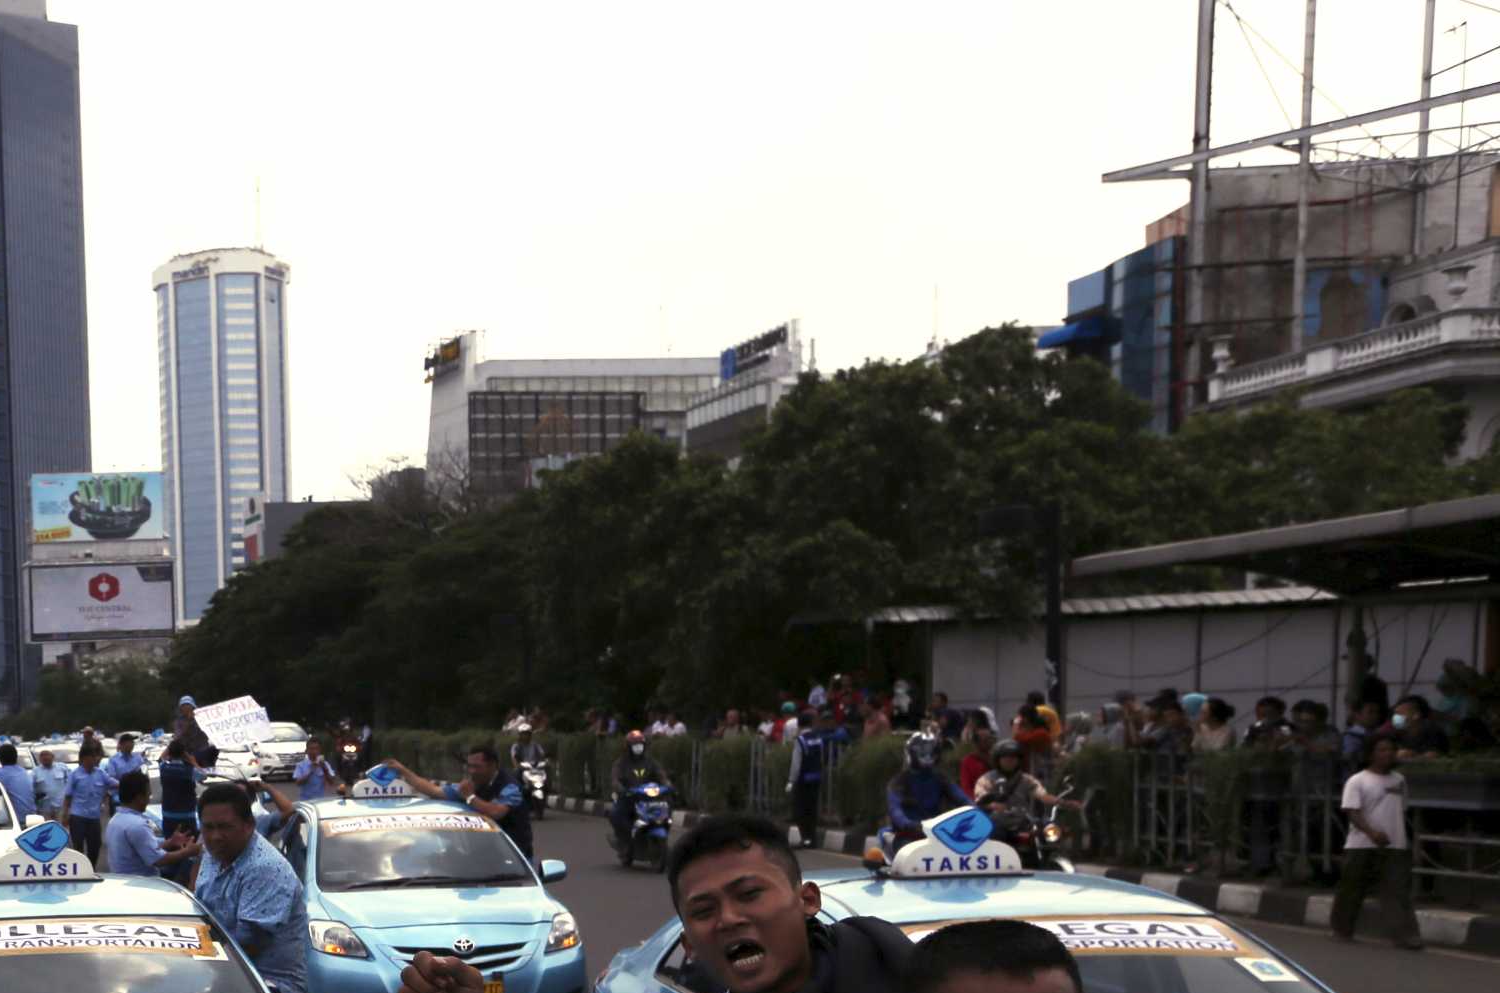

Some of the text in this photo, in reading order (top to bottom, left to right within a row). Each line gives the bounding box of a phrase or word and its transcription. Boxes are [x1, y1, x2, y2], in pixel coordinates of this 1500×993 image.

[363, 786, 404, 795] TAKSI
[10, 863, 78, 877] TAKSI
[922, 855, 1001, 872] TAKSI
[1058, 921, 1222, 939] EGAL
[1067, 938, 1238, 951] SPORTATION
